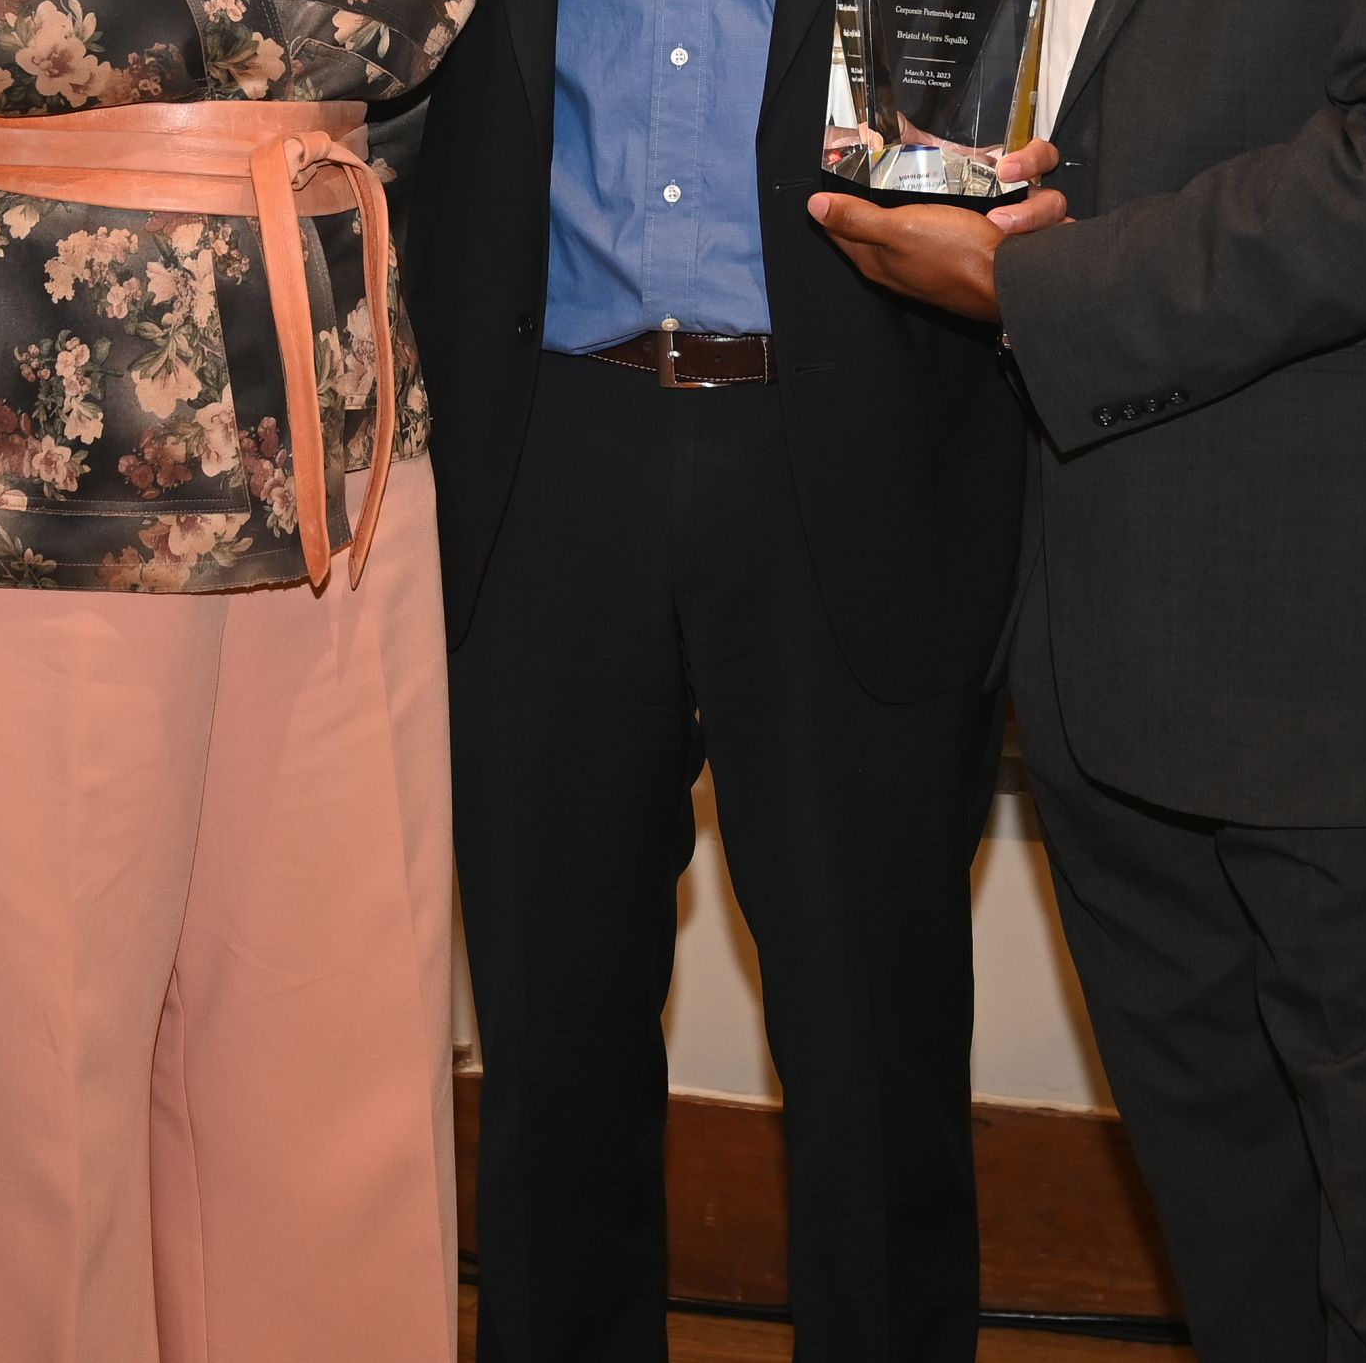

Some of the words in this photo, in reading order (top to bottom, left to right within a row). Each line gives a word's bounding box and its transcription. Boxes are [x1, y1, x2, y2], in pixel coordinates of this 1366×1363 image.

[895, 5, 922, 15] Corporate
[923, 8, 954, 19] Partnership
[961, 12, 975, 20] 2022
[897, 30, 920, 40] Bristol
[921, 33, 942, 42] Myers
[944, 35, 968, 45] Squibb
[905, 69, 924, 77] March
[902, 76, 926, 86] Atlanta,
[927, 79, 951, 88] Georgia
